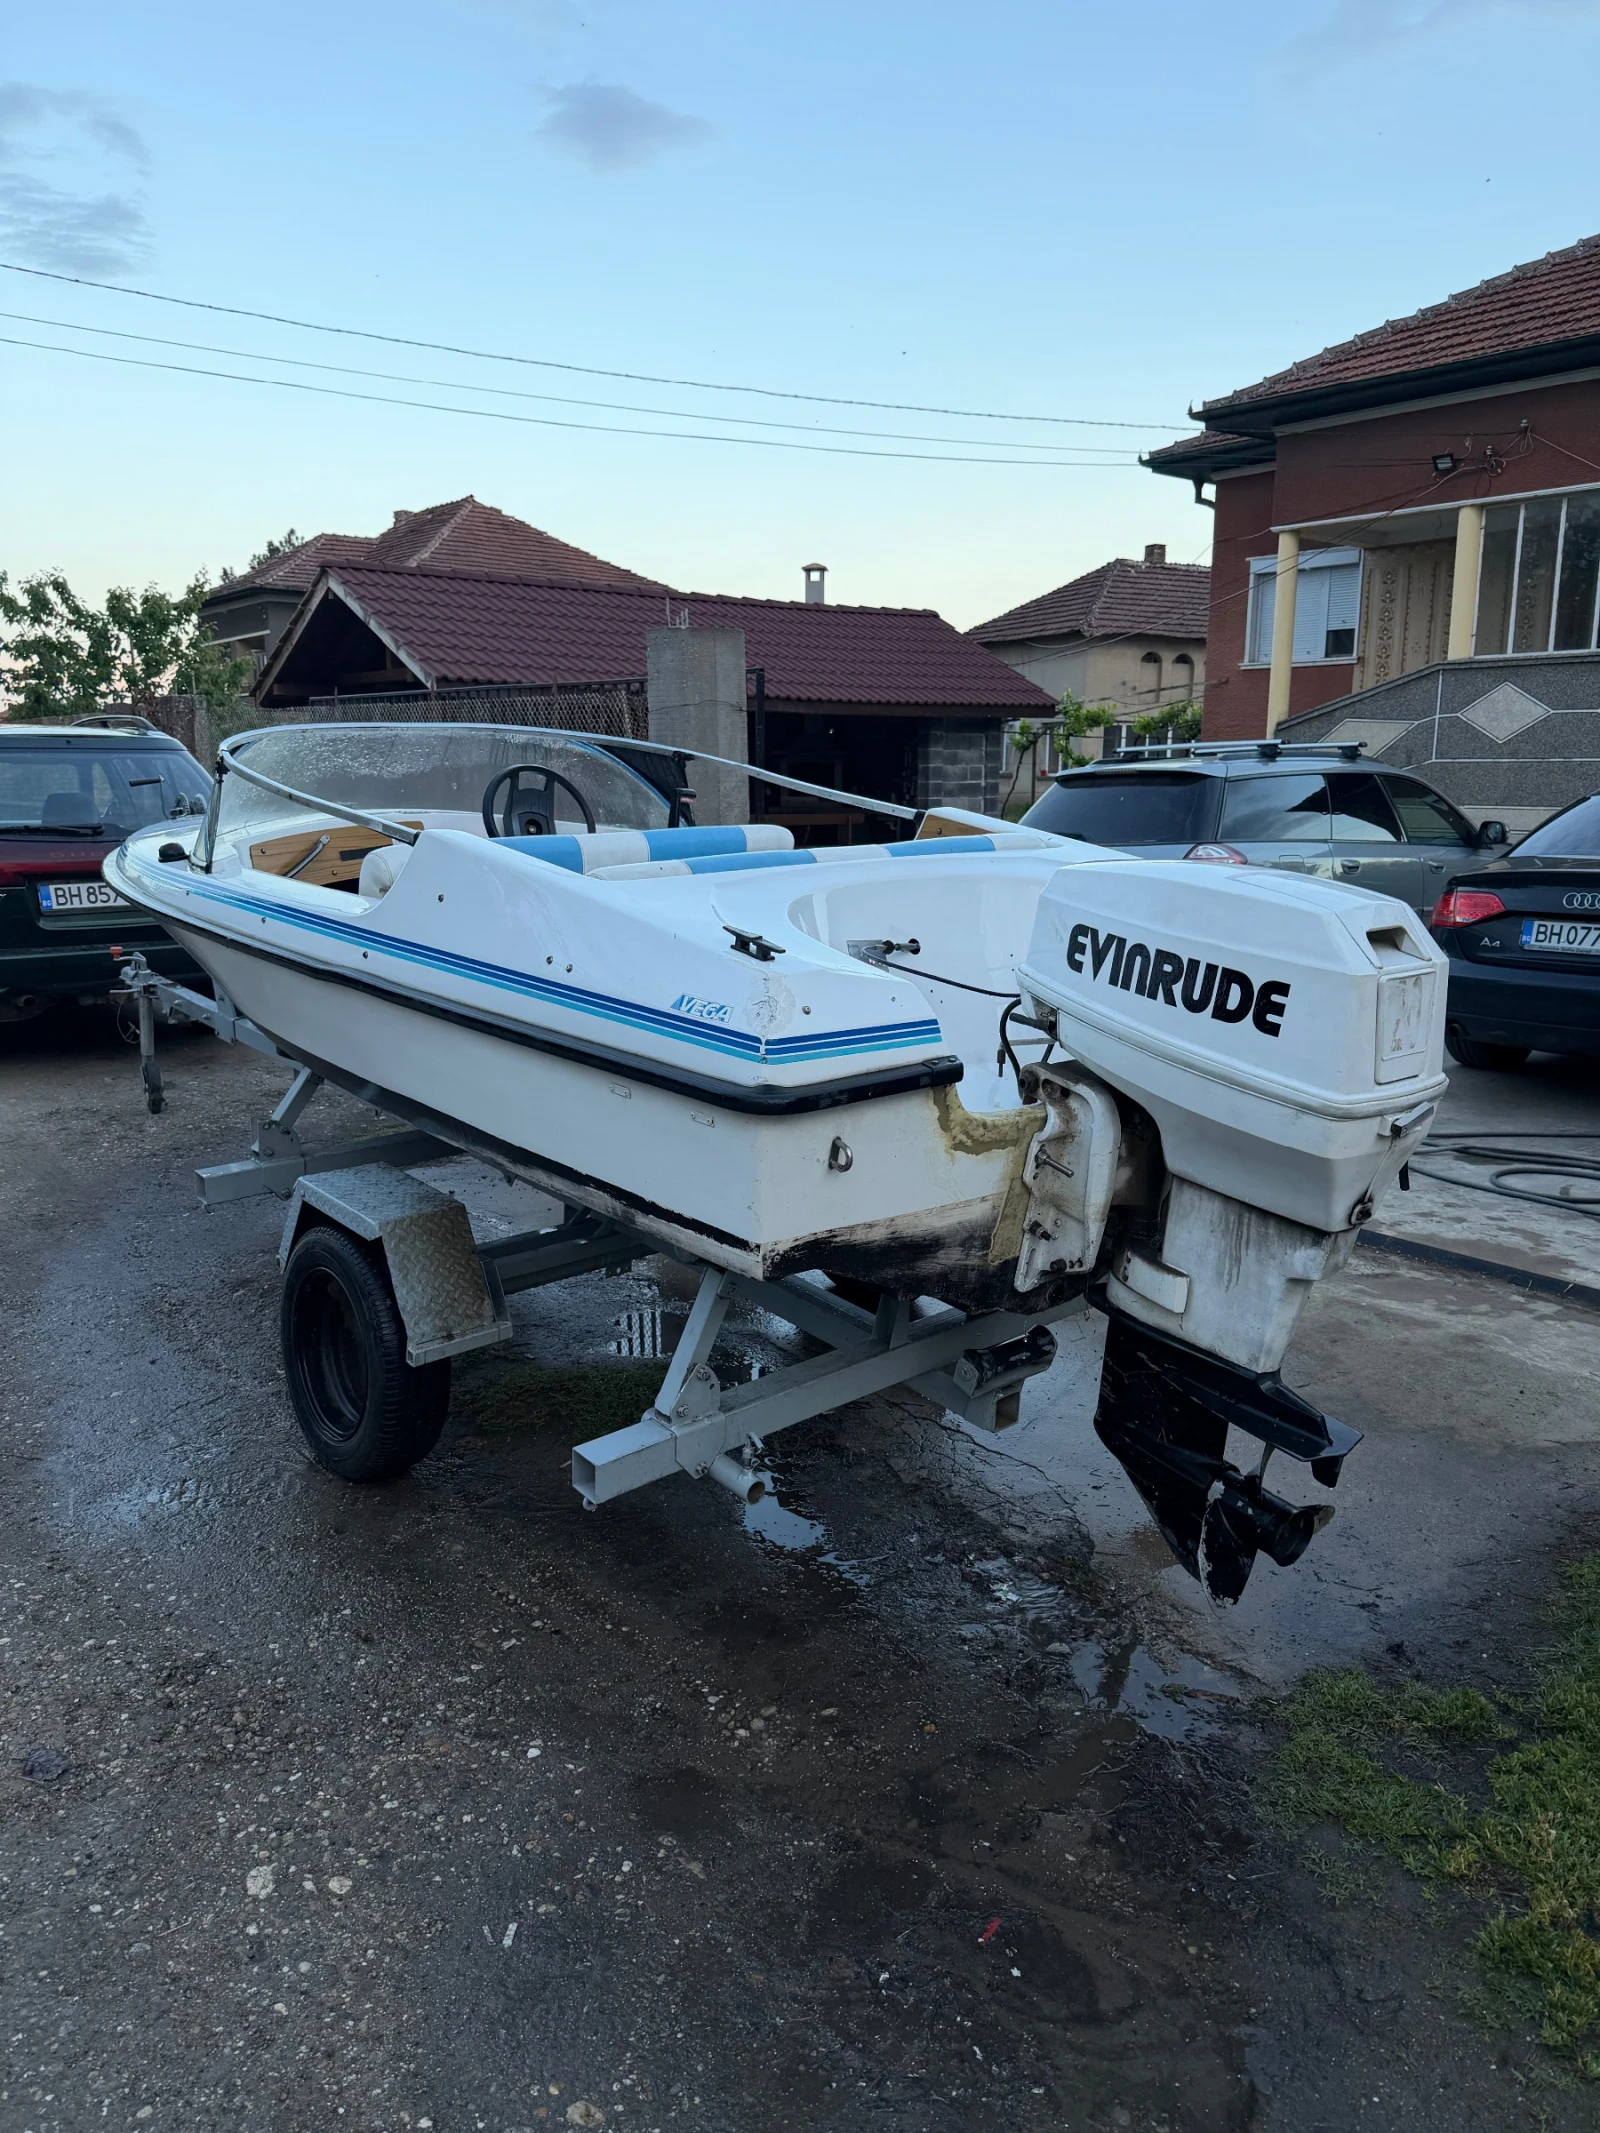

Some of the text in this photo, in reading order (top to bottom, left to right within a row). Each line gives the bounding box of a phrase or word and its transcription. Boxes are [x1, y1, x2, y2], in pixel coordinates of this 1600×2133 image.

[54, 886, 83, 906] BH
[1480, 937, 1500, 947] A4
[1535, 924, 1563, 945] BH
[1066, 923, 1291, 1037] EVINRUDE
[680, 994, 733, 1023] VEGA
